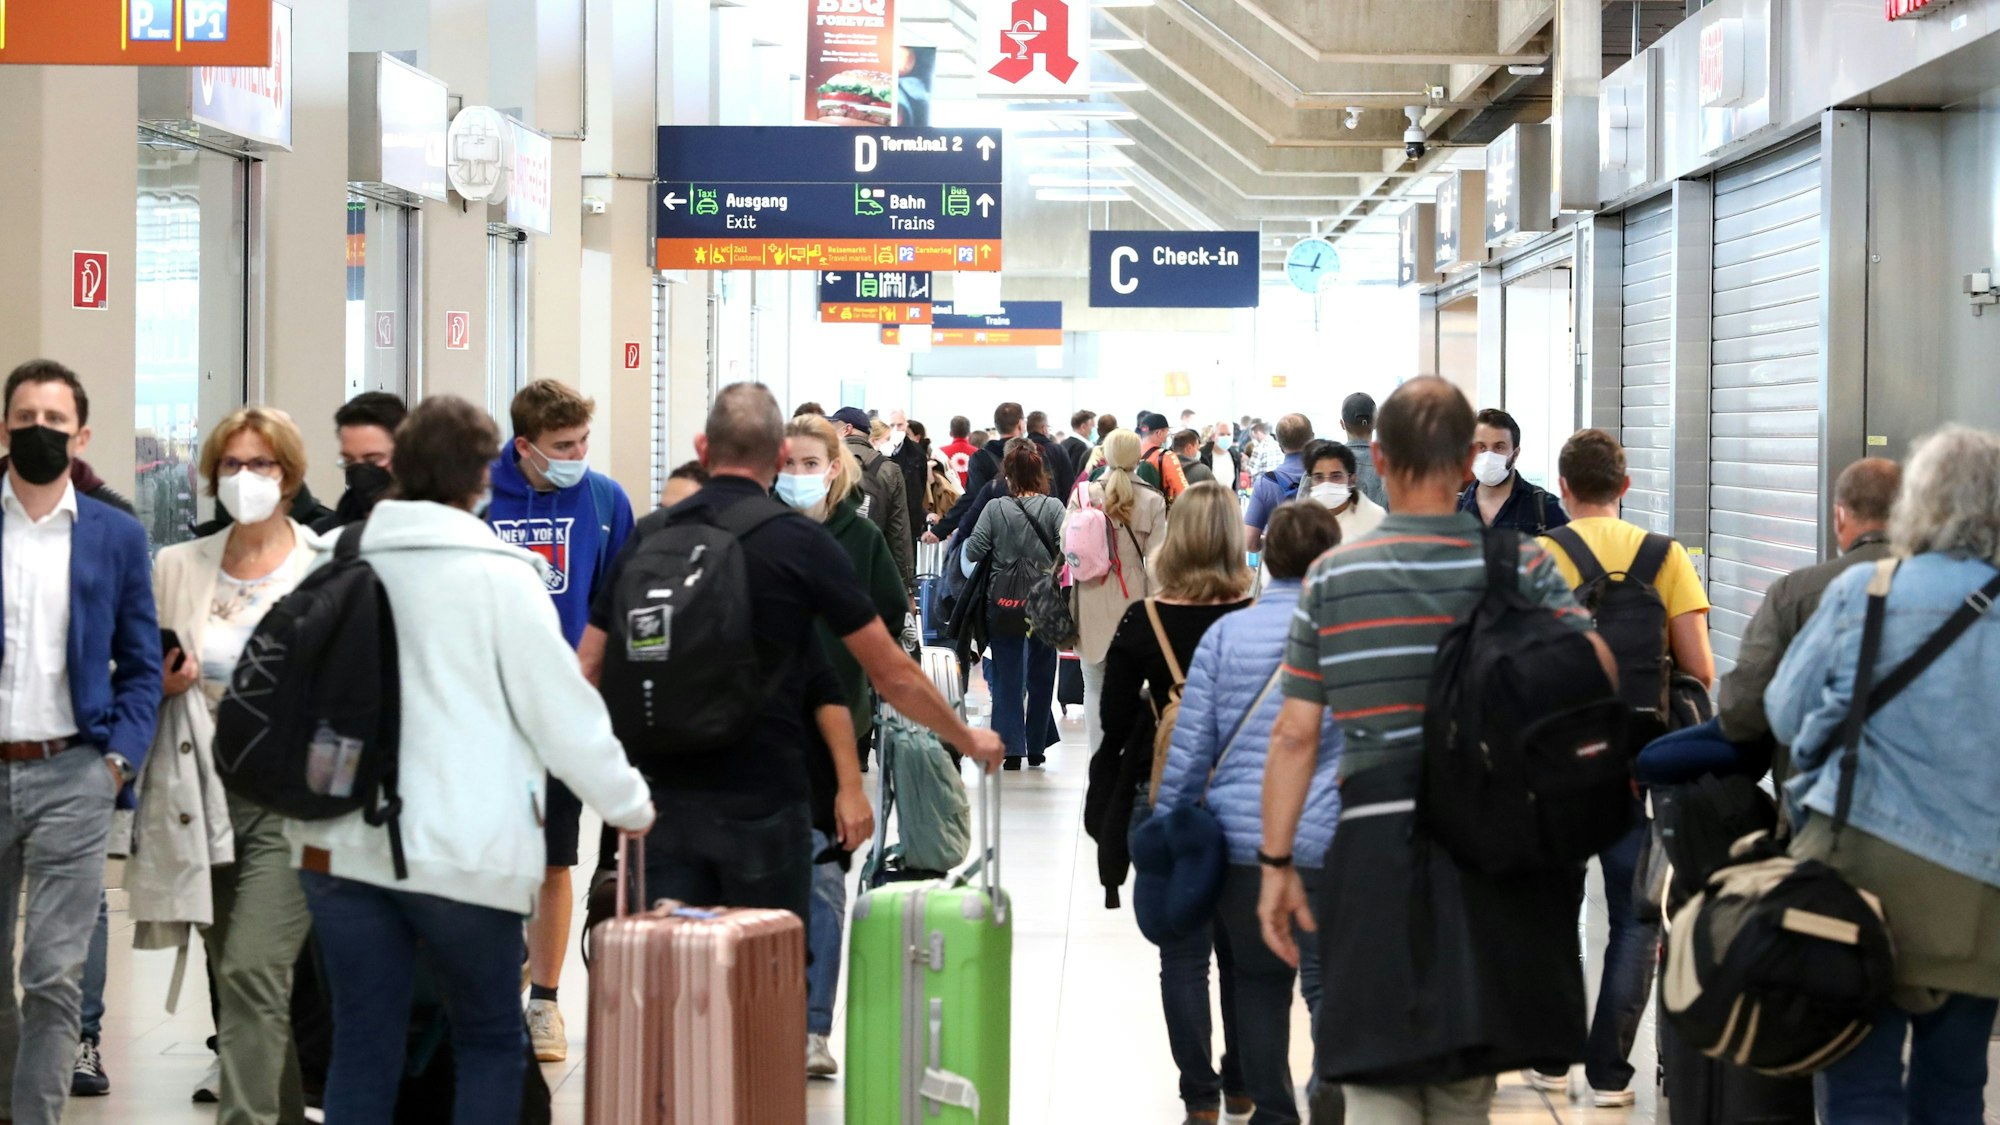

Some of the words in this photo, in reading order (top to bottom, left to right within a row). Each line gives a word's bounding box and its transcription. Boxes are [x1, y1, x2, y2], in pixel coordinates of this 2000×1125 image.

[816, 14, 885, 27] FOREVER
[855, 135, 877, 172] D
[880, 136, 947, 151] Terminal
[952, 136, 963, 151] 2
[697, 189, 717, 198] Taxi
[950, 186, 967, 195] Bus
[726, 193, 788, 211] Ausgang
[889, 194, 926, 209] Bahn
[726, 214, 757, 229] Exit
[889, 215, 935, 230] Trains
[899, 247, 914, 260] P2
[915, 246, 952, 255] Carsharing
[1110, 245, 1139, 294] C
[1152, 246, 1239, 265] Check-in
[502, 529, 526, 543] NEW
